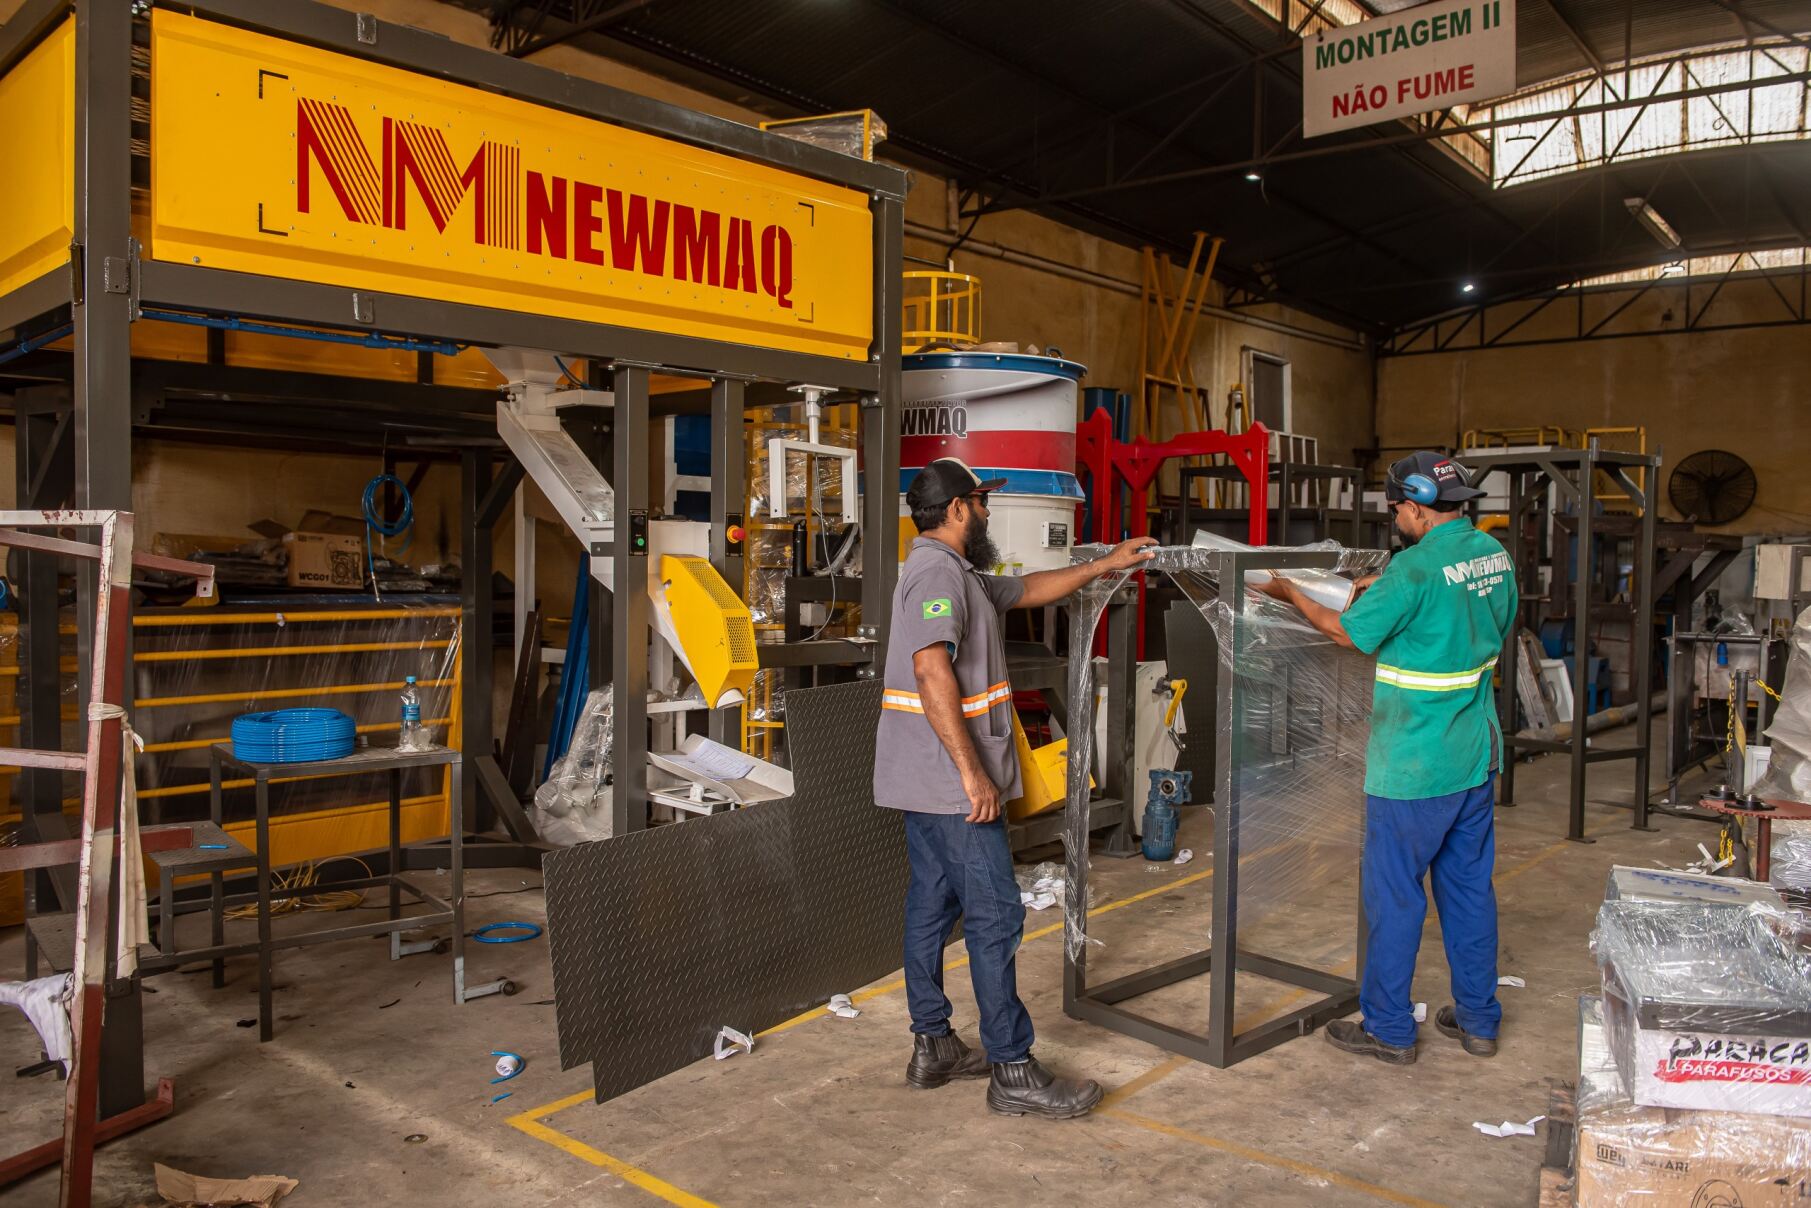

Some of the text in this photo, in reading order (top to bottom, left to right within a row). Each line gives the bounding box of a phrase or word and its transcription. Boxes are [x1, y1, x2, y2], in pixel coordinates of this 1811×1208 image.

[1315, 0, 1500, 70] MONTAGEM II
[1332, 64, 1475, 119] NÃO FUME
[297, 96, 793, 309] NM NEWMAQ
[1669, 1034, 1809, 1070] PARACA
[1680, 1060, 1792, 1081] PARAFUSOS
